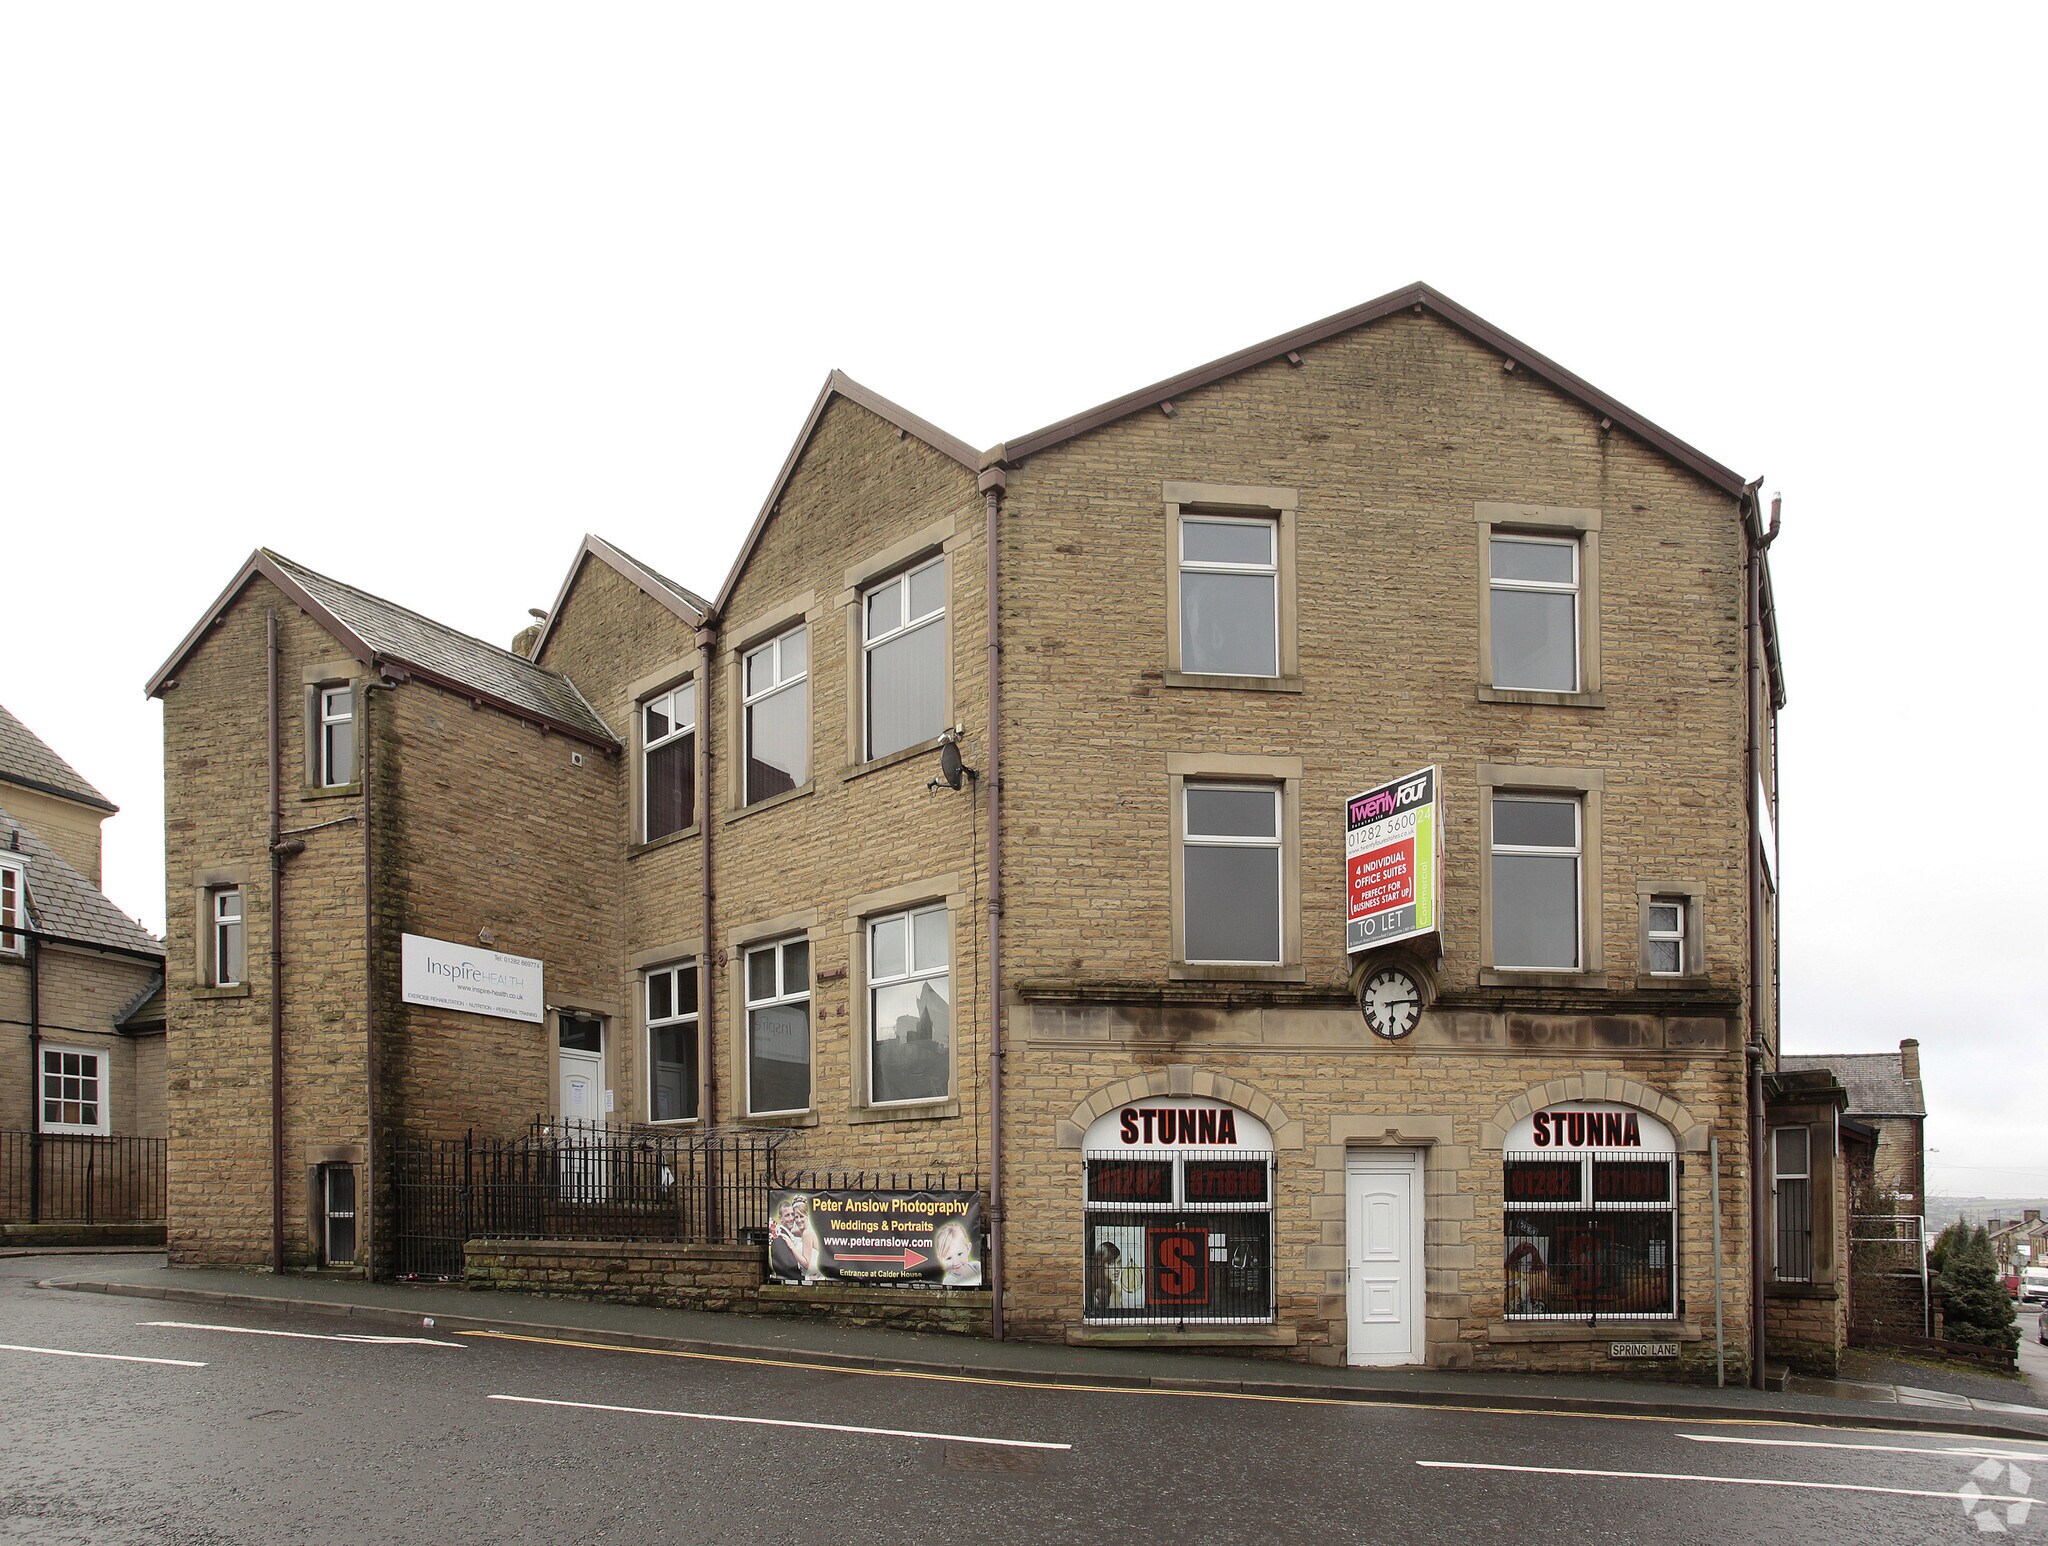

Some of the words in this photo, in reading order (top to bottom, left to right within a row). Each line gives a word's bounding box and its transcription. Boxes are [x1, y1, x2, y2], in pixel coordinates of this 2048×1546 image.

[1348, 824, 1381, 847] 01282
[1356, 866, 1361, 876] 4
[1363, 851, 1405, 873] INDIVIDUAL
[1355, 872, 1381, 889] OFFICE
[1383, 864, 1407, 880] SUITES
[1361, 885, 1386, 900] PERFECT
[1388, 881, 1401, 892] FOR
[1381, 891, 1399, 904] START
[1419, 862, 1428, 925] Commercial
[1358, 918, 1375, 937] TO
[1382, 910, 1403, 931] LET
[504, 957, 520, 966] 01282
[457, 984, 524, 1001] www.inspire-health.co.uk
[407, 992, 430, 1002] EXERCISE
[430, 995, 465, 1006] REHABILITATION
[468, 1002, 492, 1011] NUTRITION
[496, 1006, 518, 1015] PERSONAL
[518, 1010, 538, 1018] TRAINING
[1119, 1108, 1238, 1145] STUNNA
[1532, 1111, 1642, 1148] STUNNA
[1512, 1170, 1571, 1195] 01282
[813, 1198, 842, 1212] Peter
[845, 1198, 889, 1213] Anslow
[892, 1199, 969, 1216] Photography
[831, 1219, 879, 1233] Weddings
[881, 1221, 889, 1231] &
[891, 1220, 934, 1232] Portraits
[823, 1236, 933, 1248] www.peteranslow.com
[840, 1268, 869, 1278] Entrance
[870, 1269, 877, 1278] at
[878, 1269, 900, 1278] Calder
[1160, 1237, 1196, 1295] S
[1612, 1344, 1647, 1356] SPRING
[1651, 1344, 1677, 1355] LANE
